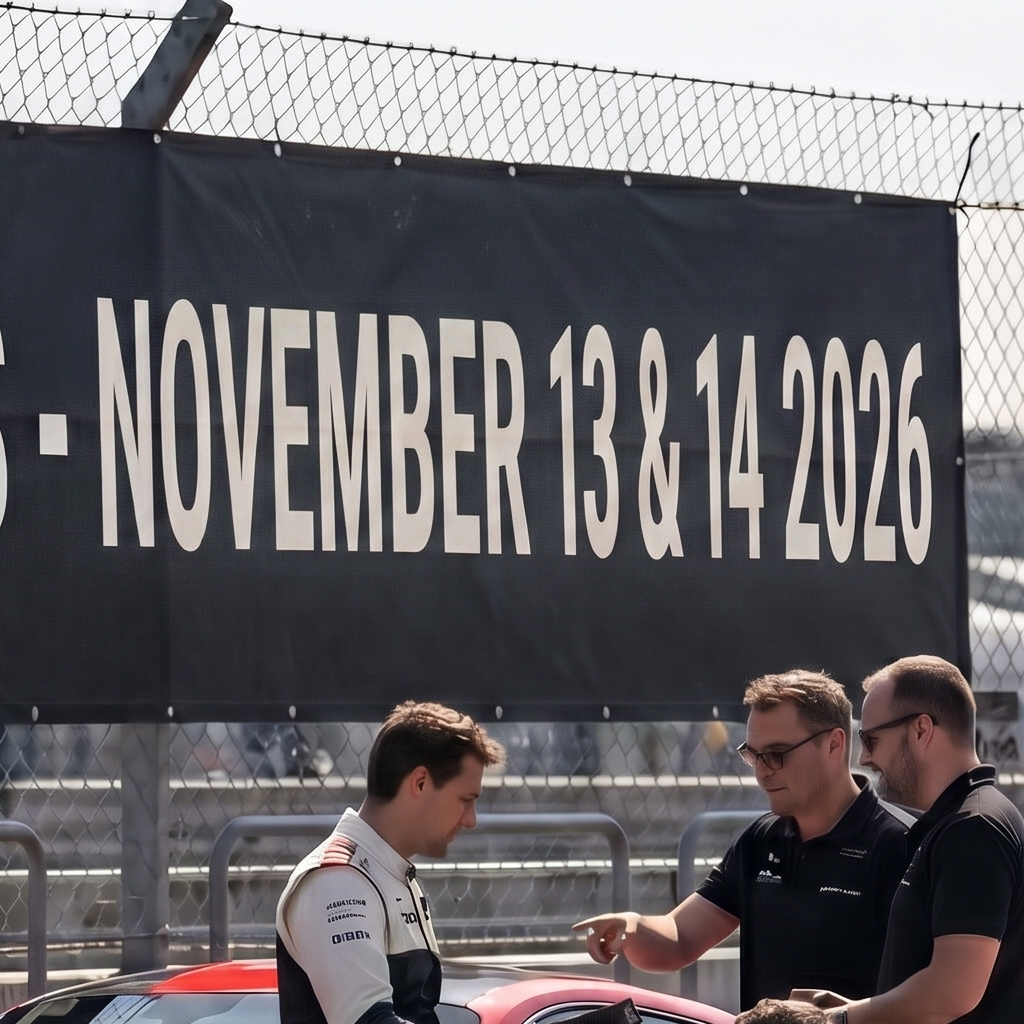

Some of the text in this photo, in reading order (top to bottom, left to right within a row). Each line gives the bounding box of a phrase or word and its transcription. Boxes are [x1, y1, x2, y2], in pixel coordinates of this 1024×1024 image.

[38, 413, 69, 456] -
[96, 297, 532, 556] NOVEMBER
[549, 324, 620, 559] 13
[638, 327, 685, 561] &
[696, 333, 765, 559] 14
[782, 334, 933, 566] 2026
